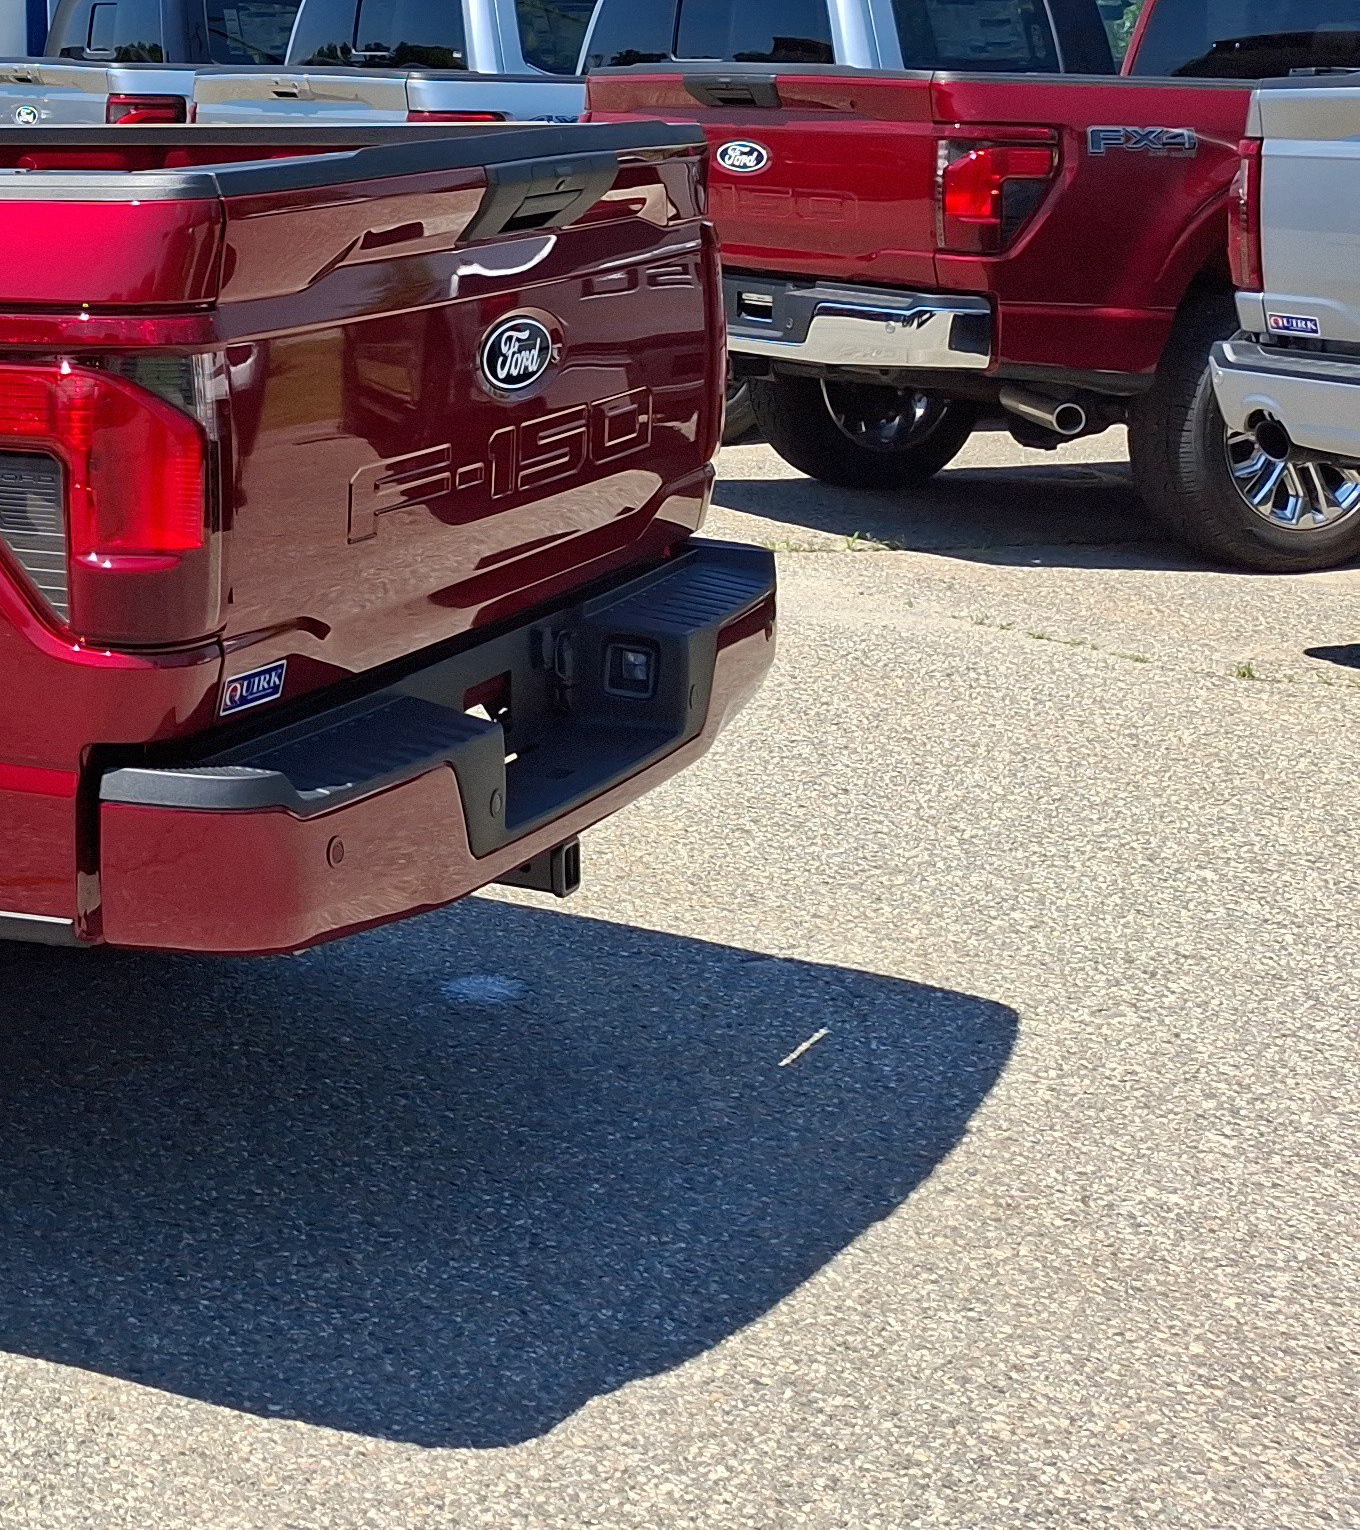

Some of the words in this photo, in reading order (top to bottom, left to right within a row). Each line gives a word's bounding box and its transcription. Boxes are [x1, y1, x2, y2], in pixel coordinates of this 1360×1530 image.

[724, 144, 759, 167] Ford
[1087, 125, 1198, 156] FX4
[1270, 316, 1317, 330] QUIRK
[496, 329, 542, 379] Ford
[347, 386, 653, 544] F-150
[226, 669, 282, 706] QUIRK
